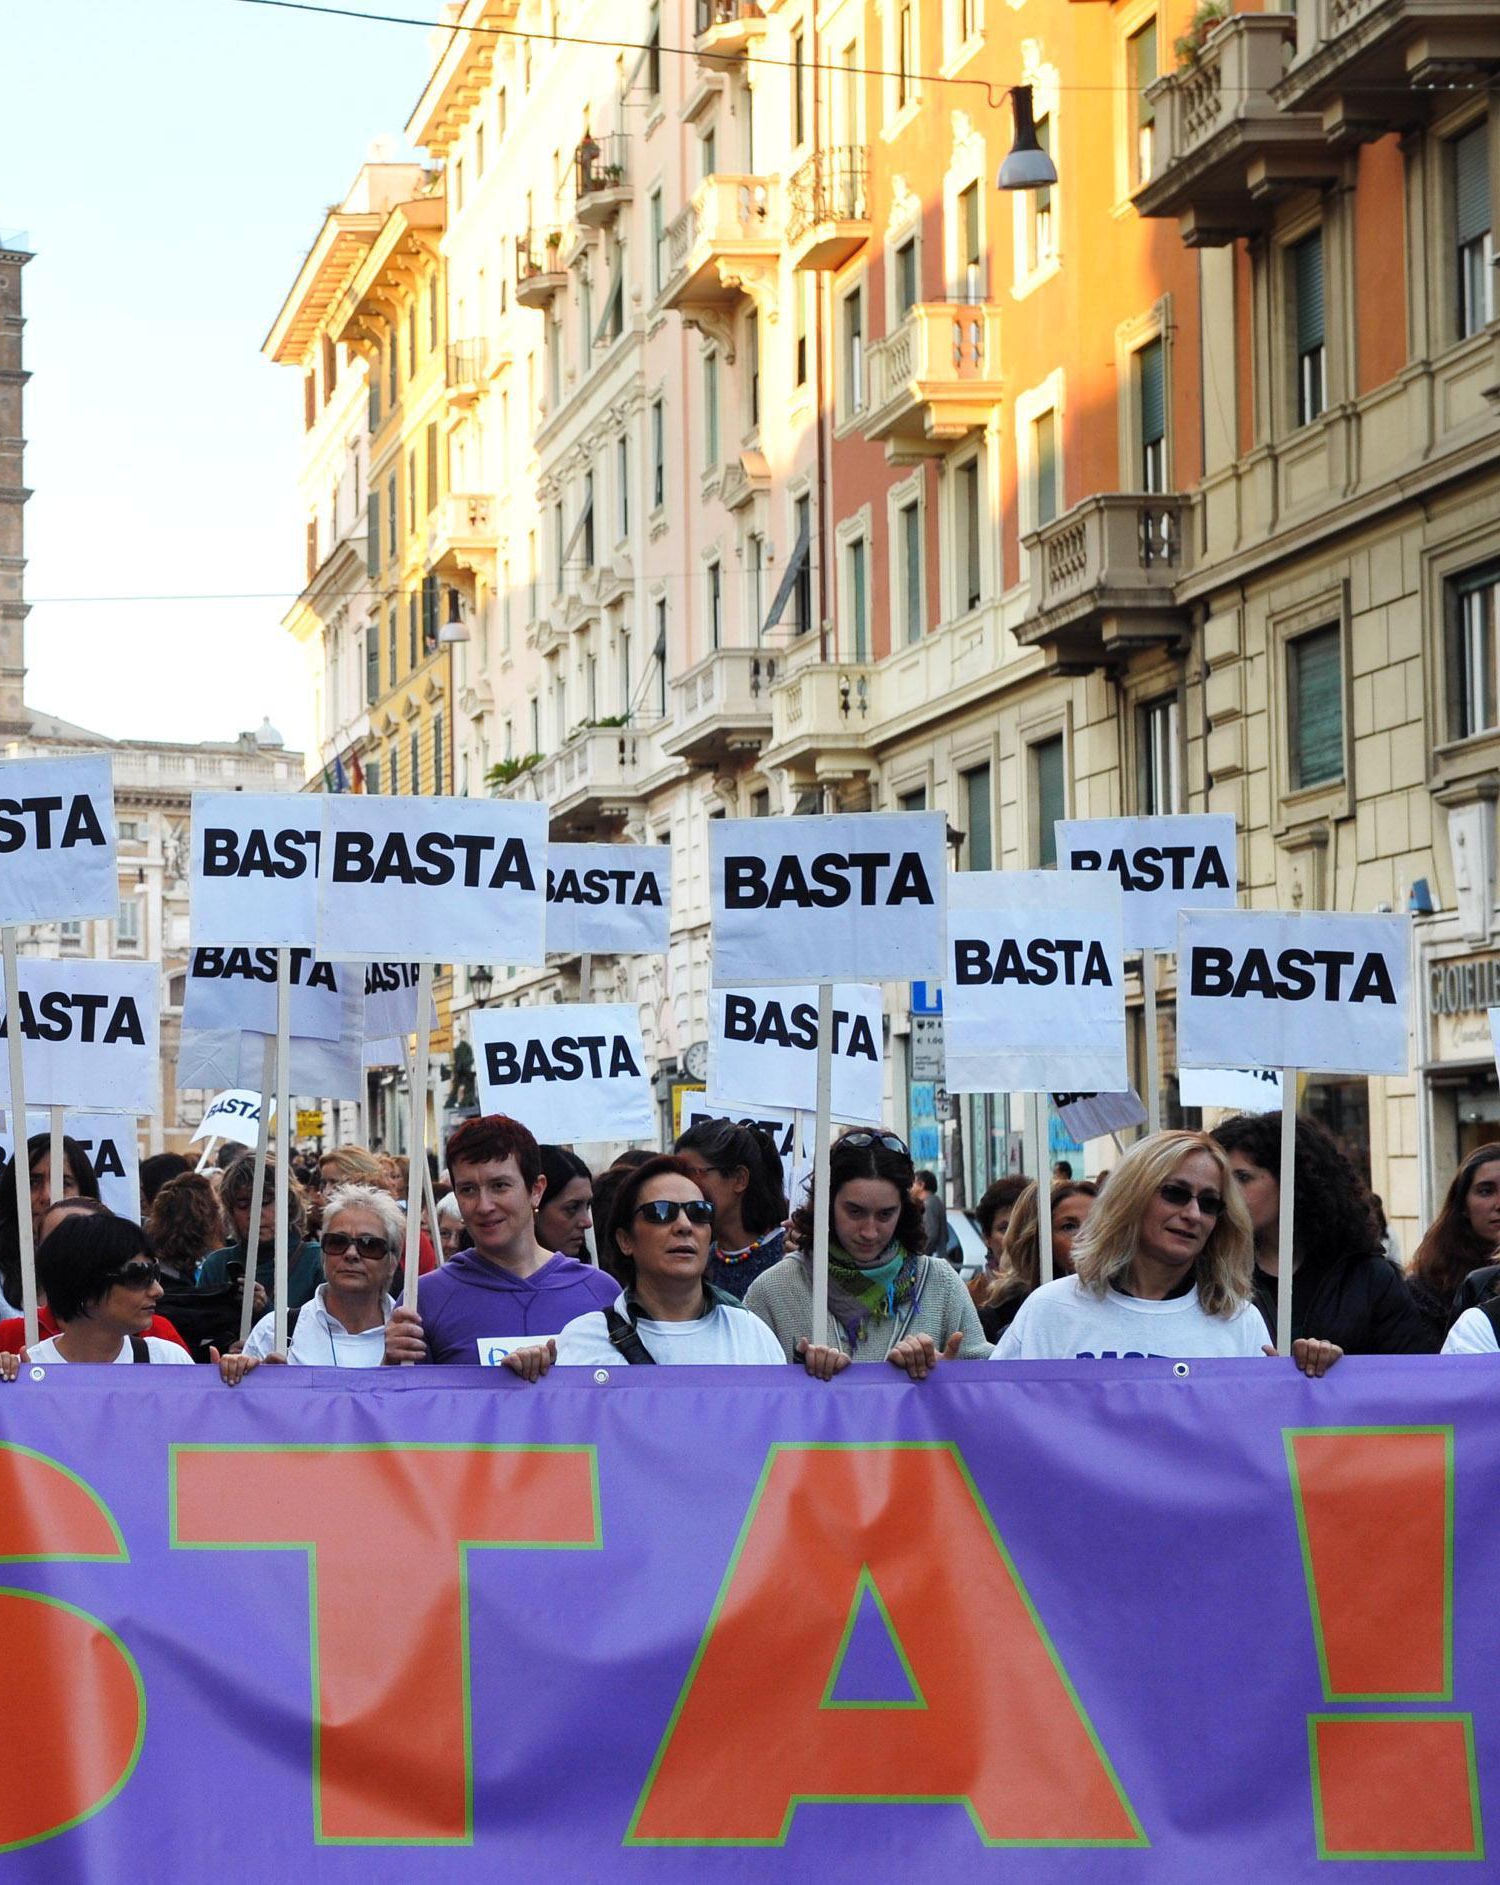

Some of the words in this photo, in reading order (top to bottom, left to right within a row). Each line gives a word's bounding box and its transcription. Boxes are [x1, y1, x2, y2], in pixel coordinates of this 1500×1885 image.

[203, 829, 320, 878] BAS
[332, 832, 536, 890] BASTA
[724, 852, 934, 909] BASTA
[192, 947, 338, 993] BASTA
[364, 962, 420, 995] ASTA
[954, 938, 1112, 986] BASTA
[1190, 946, 1397, 1004] BASTA
[724, 994, 878, 1061] BASTA
[485, 1035, 640, 1085] BASTA
